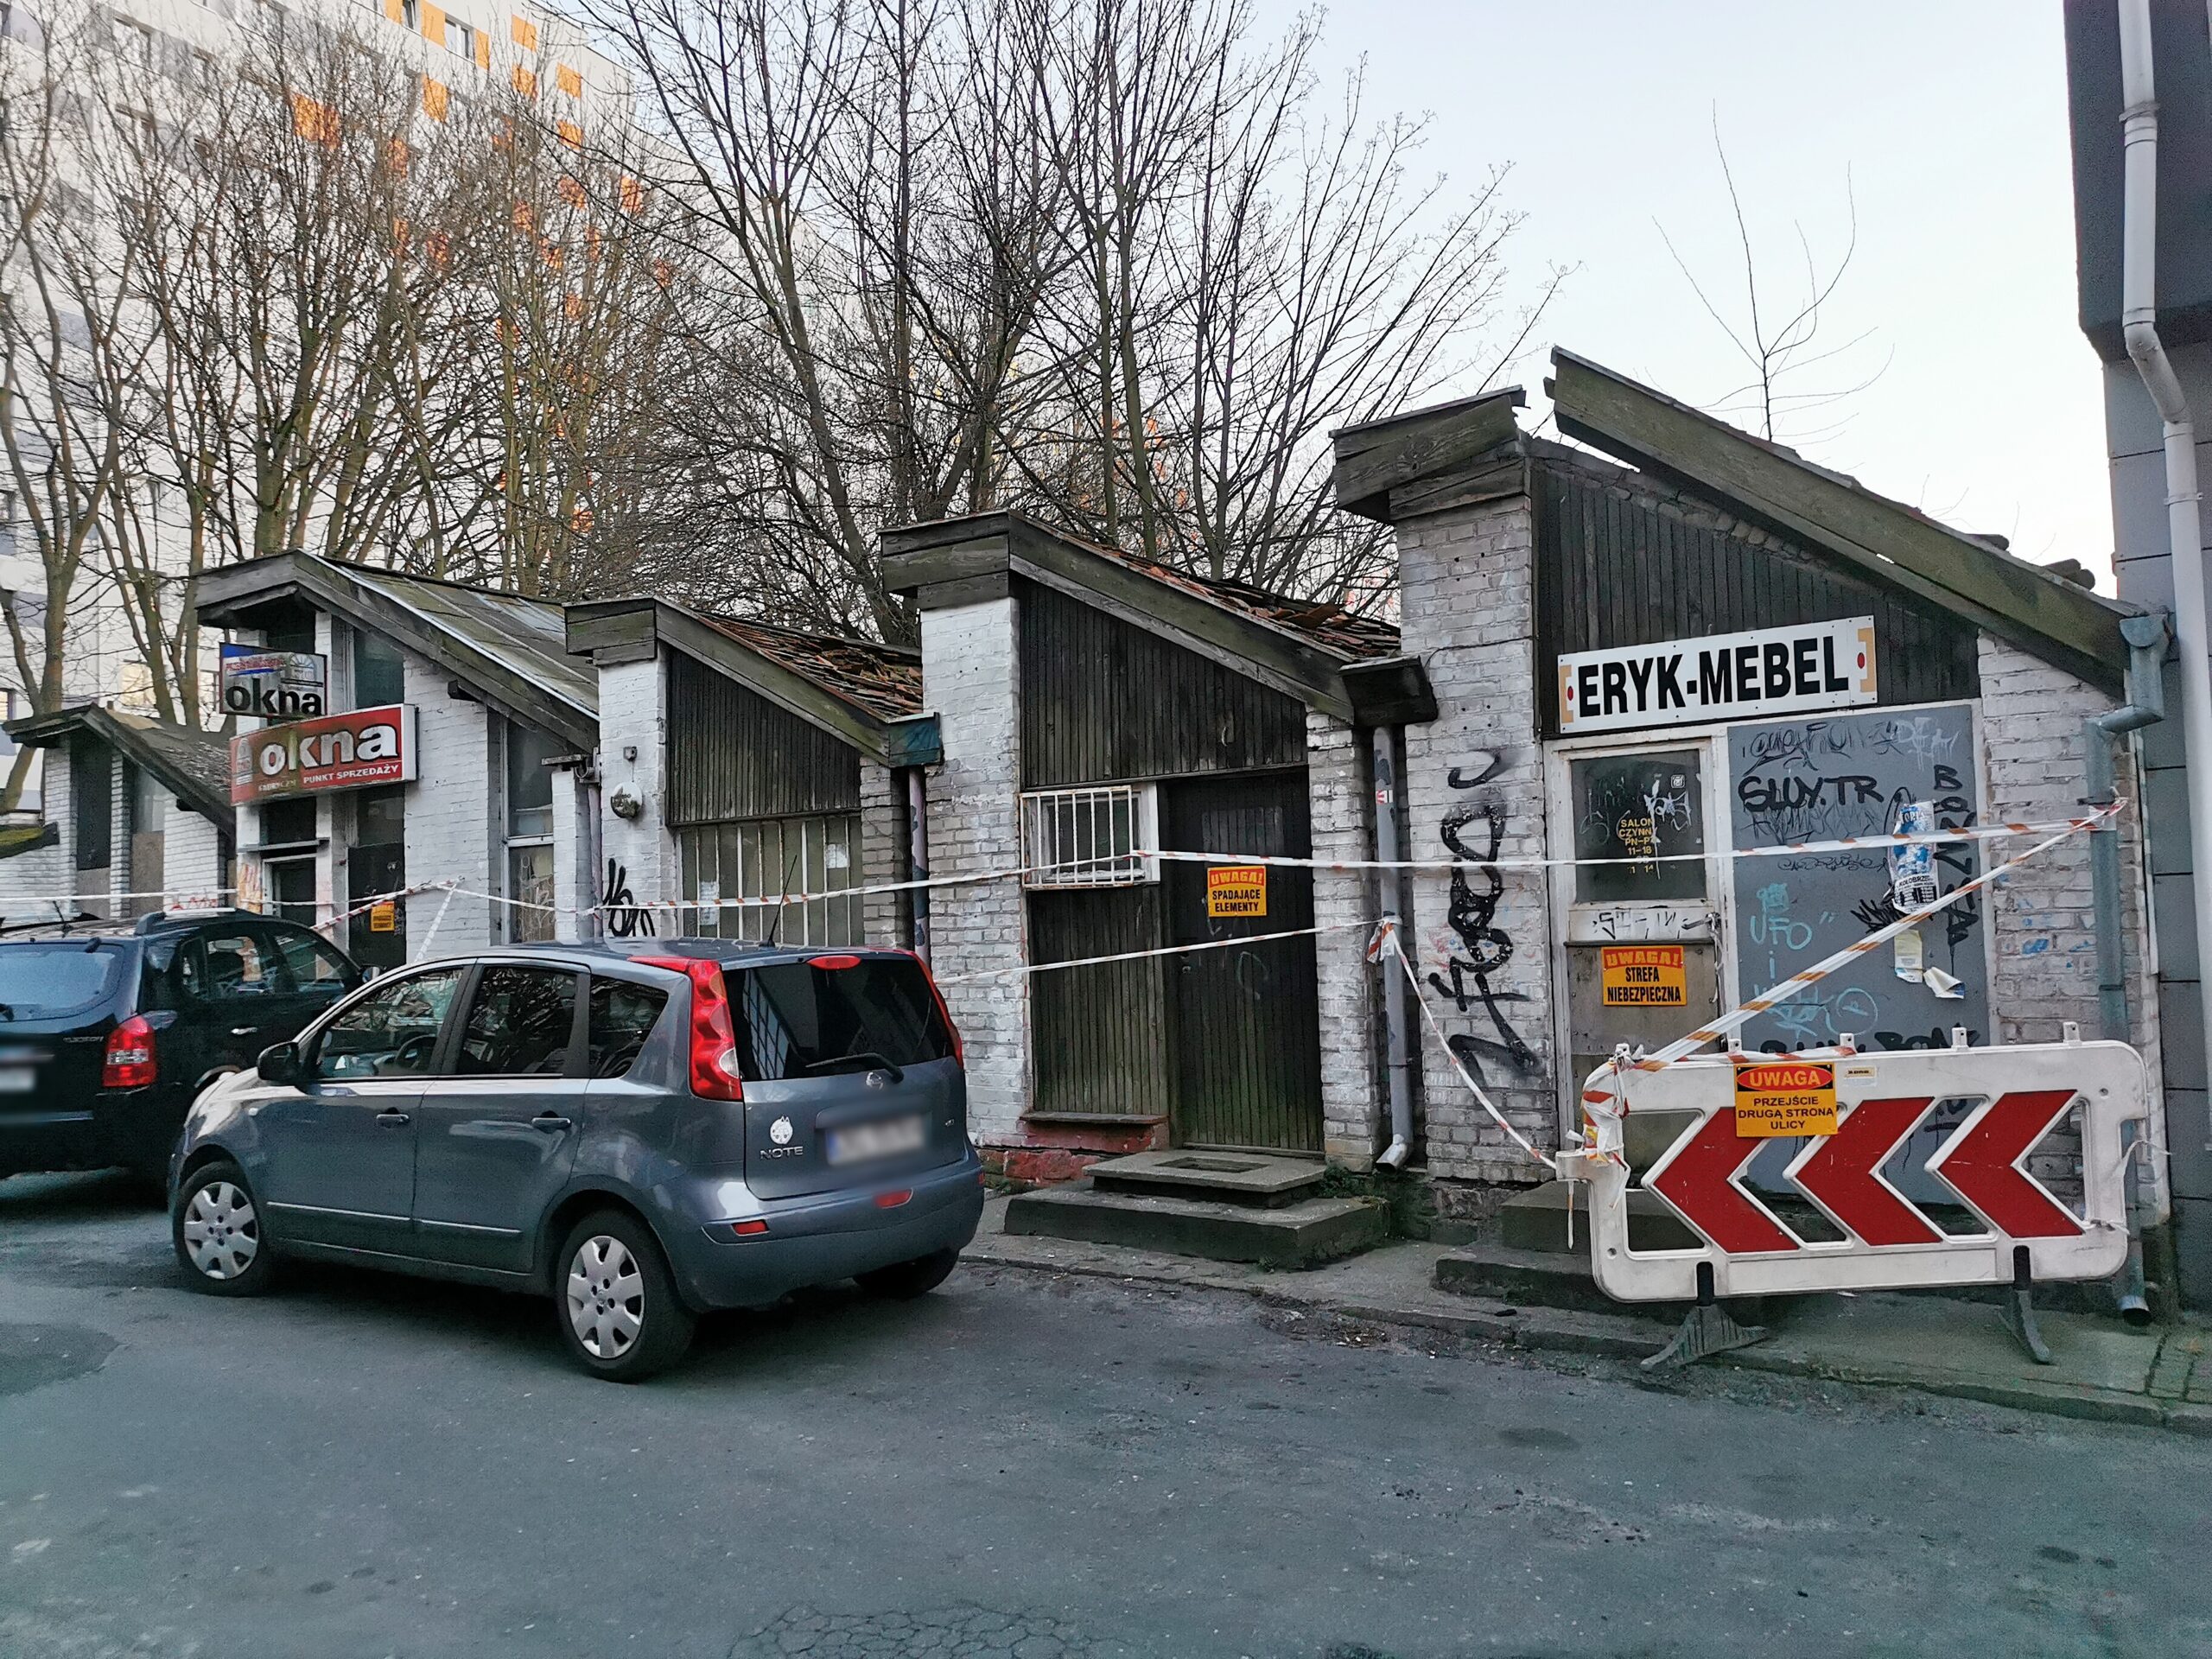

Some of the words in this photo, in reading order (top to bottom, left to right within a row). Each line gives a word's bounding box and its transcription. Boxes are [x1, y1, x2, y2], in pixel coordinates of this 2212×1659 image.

[1578, 636, 1848, 717] ERYK-MEBEL
[226, 678, 321, 715] okna
[259, 723, 398, 775] okna
[303, 772, 334, 784] PUNKT
[336, 763, 399, 780] SPRZEDAŻY
[1620, 817, 1654, 828] SALON
[1627, 845, 1653, 855] 11-18
[1211, 871, 1263, 885] UWAGA!
[1212, 889, 1261, 901] SPADAJĄCE
[1215, 902, 1259, 912] ELEMENTY
[1605, 950, 1682, 968] UWAGA!
[1625, 967, 1659, 982] STREFA
[1607, 986, 1681, 1002] NIEBEZPIECZNA
[1749, 1071, 1821, 1087] UWAGA
[1753, 1096, 1819, 1107] PRZEJŚCIE
[1738, 1108, 1783, 1119] DRUGĄ
[1770, 1120, 1806, 1129] ULICY
[760, 1145, 804, 1160] NOTE
